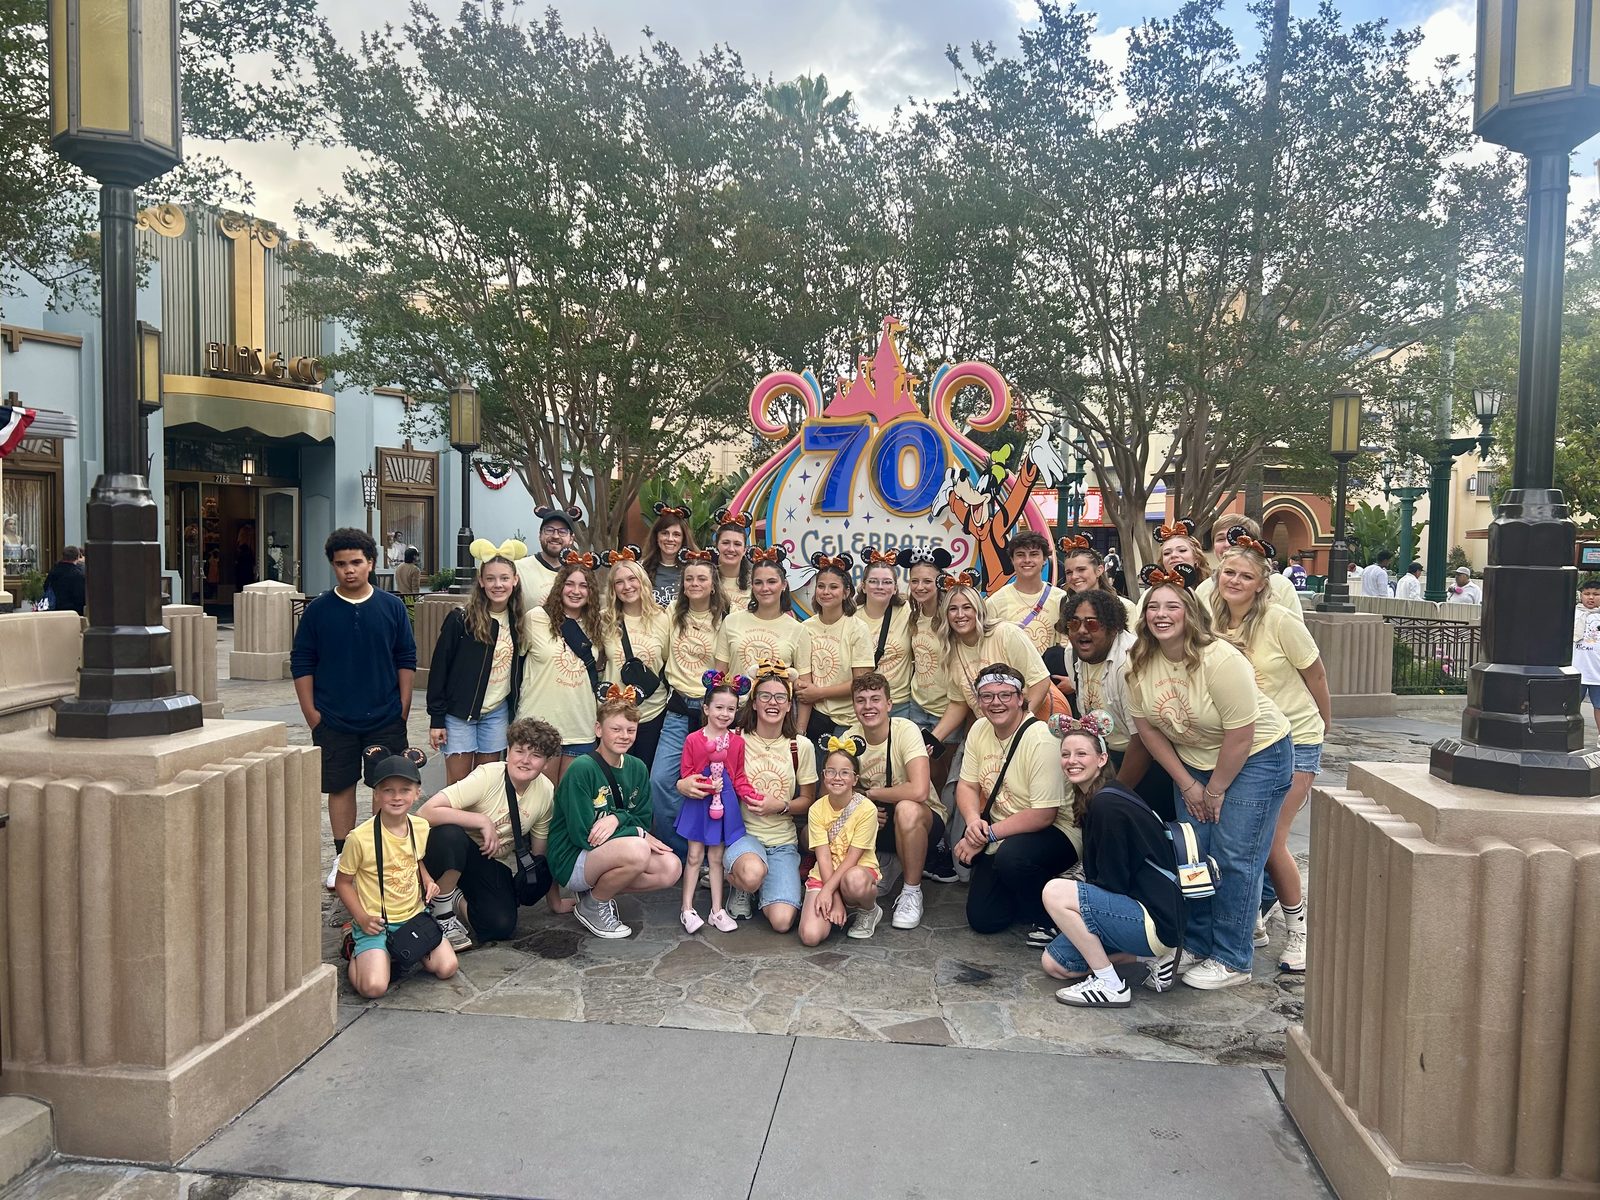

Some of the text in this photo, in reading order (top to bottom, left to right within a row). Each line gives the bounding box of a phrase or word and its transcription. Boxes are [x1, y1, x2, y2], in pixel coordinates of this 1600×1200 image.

[802, 415, 952, 517] 70
[801, 530, 944, 565] CELEBRATE
[1295, 578, 1307, 587] 32
